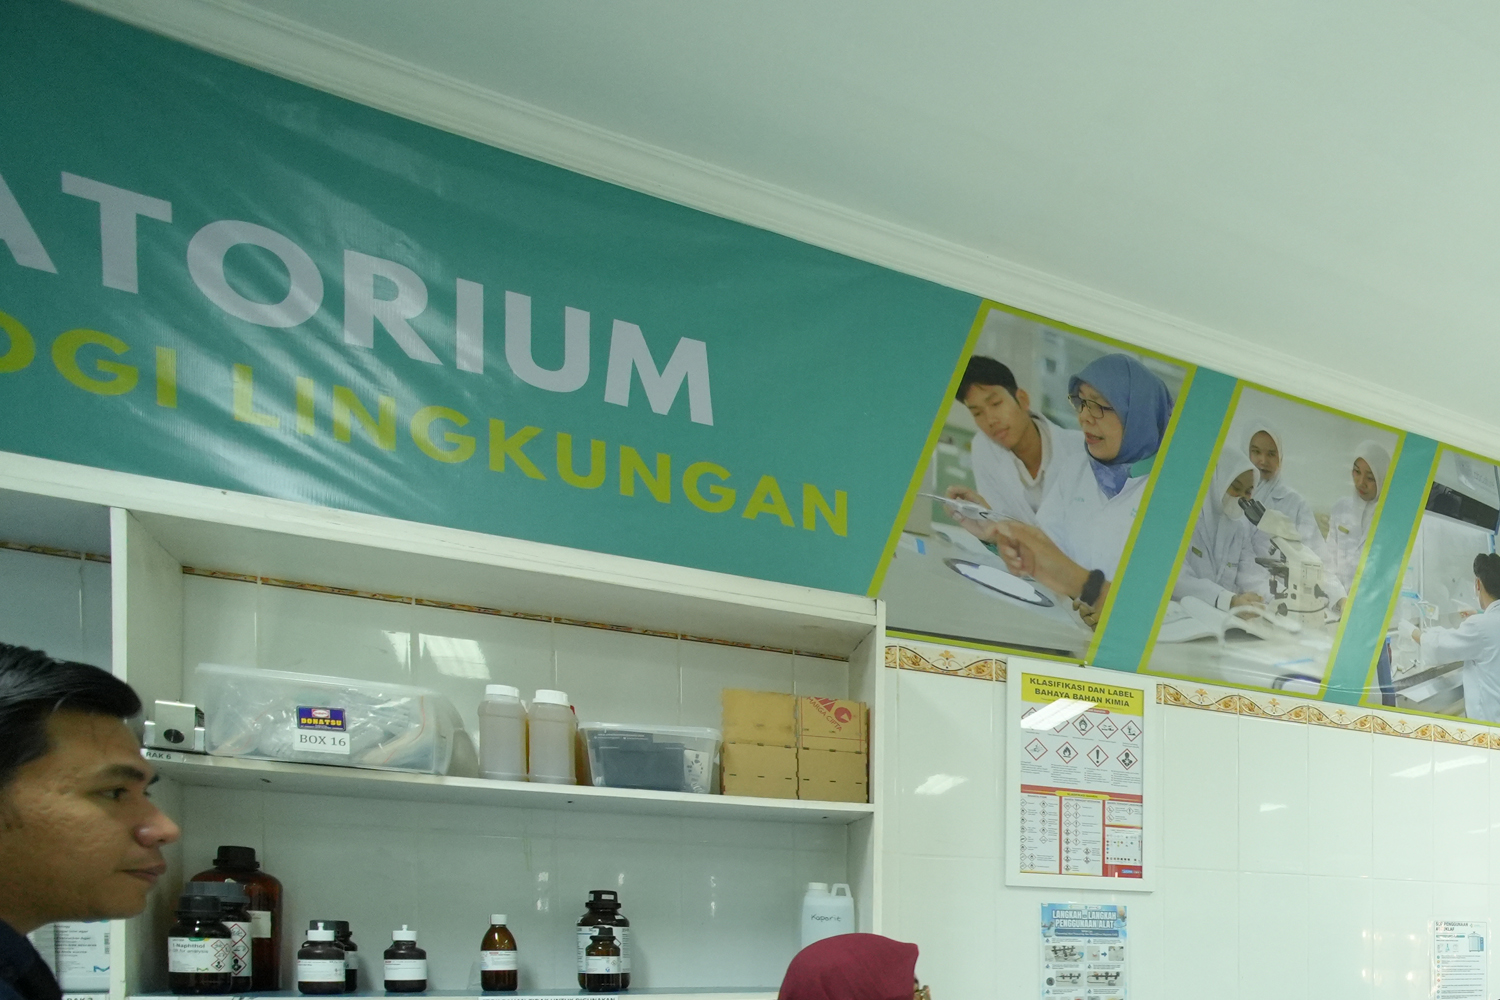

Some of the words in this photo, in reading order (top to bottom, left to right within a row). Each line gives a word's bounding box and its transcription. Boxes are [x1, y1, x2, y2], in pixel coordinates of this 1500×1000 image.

[233, 364, 850, 538] LINGKUNGAN
[1029, 677, 1086, 691] KLASIFIKASI
[1088, 685, 1106, 694] DAN
[1107, 688, 1135, 699] LABEL
[1034, 687, 1071, 699] BAHAYA
[1072, 692, 1103, 704] BAHAN
[1105, 697, 1130, 707] KIMIA
[299, 734, 327, 746] BOX
[331, 737, 347, 747] 16
[1052, 910, 1082, 919] LANGKAH
[1088, 911, 1117, 920] LANGKAH
[1099, 920, 1115, 929] ALAT
